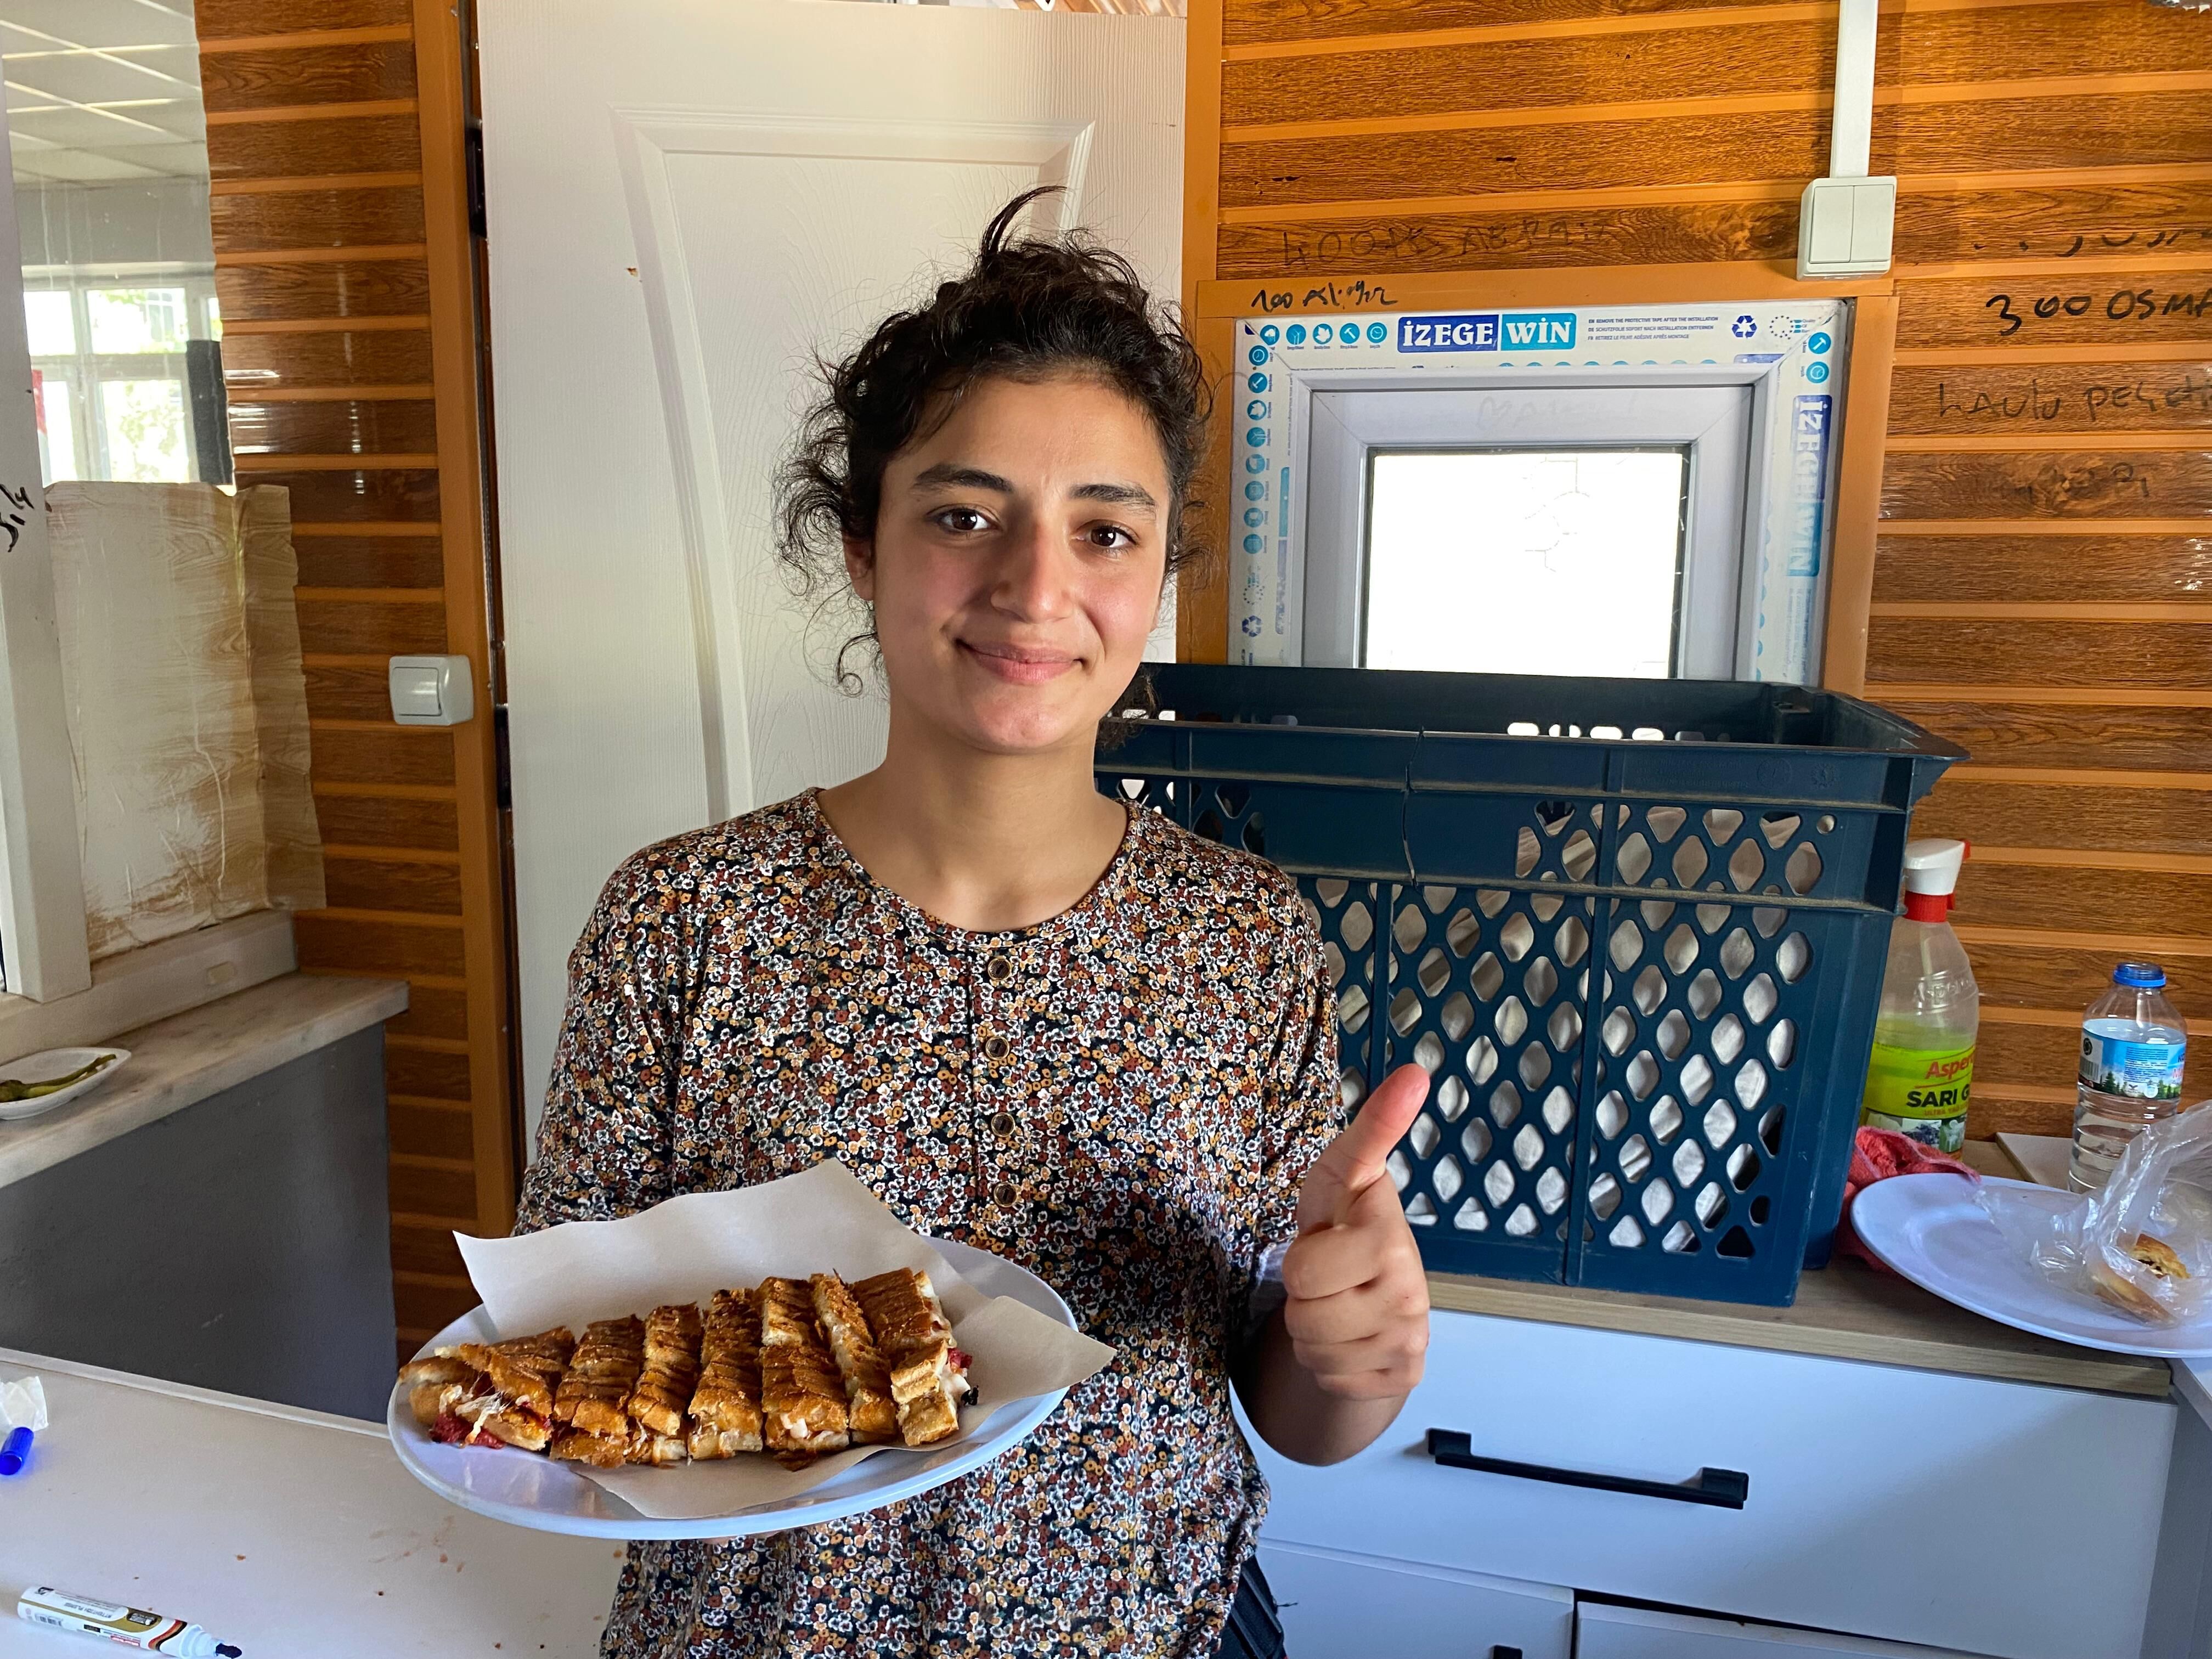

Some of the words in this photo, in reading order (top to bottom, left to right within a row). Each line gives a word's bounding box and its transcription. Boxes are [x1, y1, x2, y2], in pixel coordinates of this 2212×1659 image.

[1986, 294, 2091, 336] 300
[1403, 320, 1493, 347] İZEGE
[1506, 317, 1572, 344] WİN
[1906, 1088, 1958, 1108] SARI
